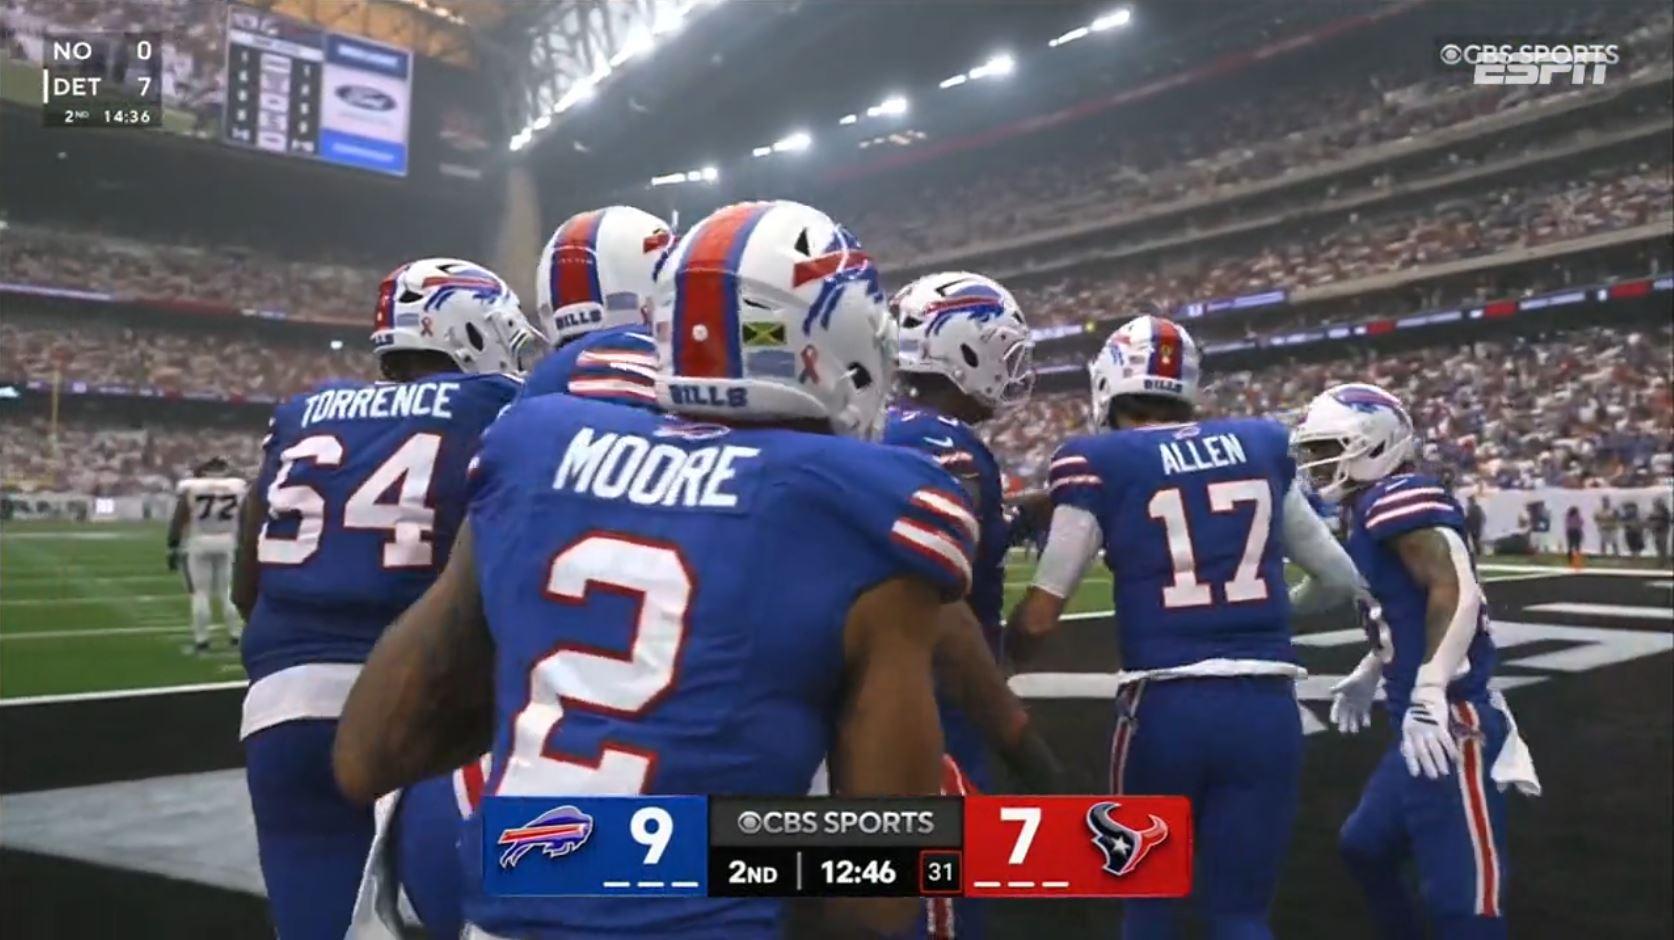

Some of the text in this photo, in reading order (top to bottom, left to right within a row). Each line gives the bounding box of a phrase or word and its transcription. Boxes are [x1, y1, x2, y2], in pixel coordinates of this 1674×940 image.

[301, 382, 460, 429] TORRENCE
[552, 427, 762, 508] MOORE
[1159, 432, 1247, 476] ALLEN
[195, 492, 238, 521] 72
[256, 431, 444, 569] 64
[1147, 477, 1275, 609] 17
[495, 530, 698, 795] 2
